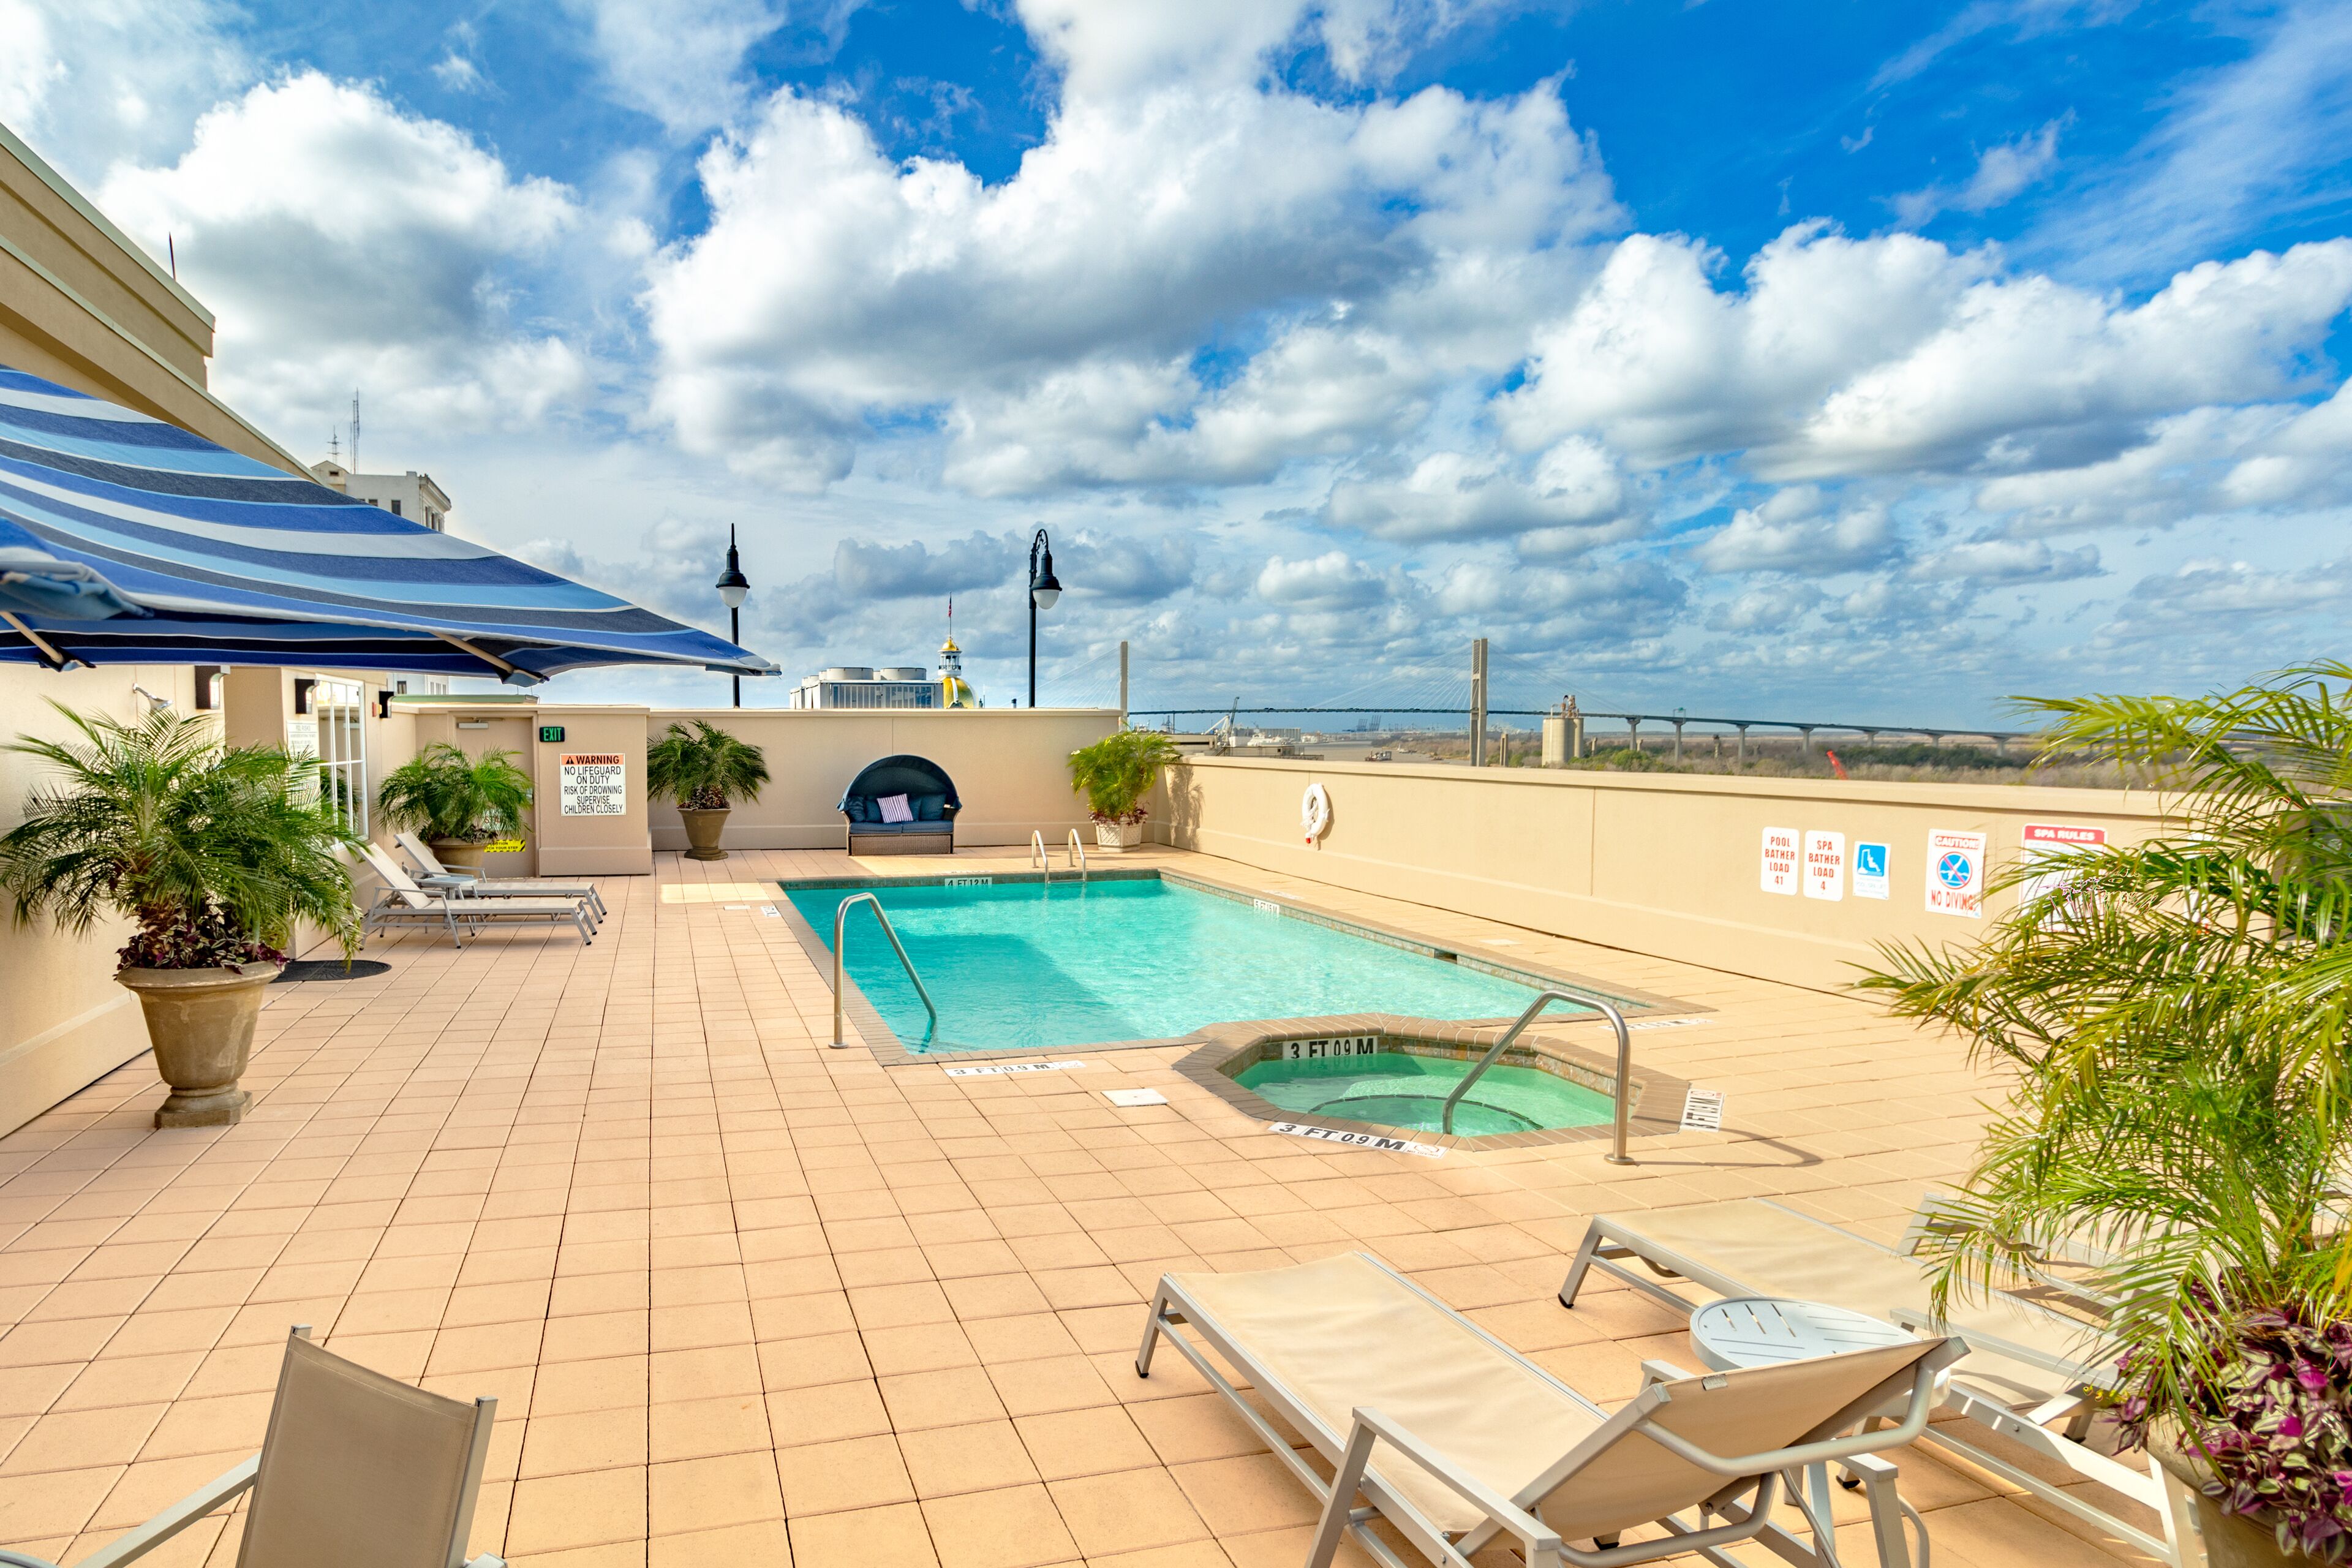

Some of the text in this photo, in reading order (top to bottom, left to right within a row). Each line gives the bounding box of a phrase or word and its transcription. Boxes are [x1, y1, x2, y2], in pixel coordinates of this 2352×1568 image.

[543, 728, 562, 741] EXIT
[576, 756, 619, 764] WARNING
[564, 766, 621, 775] NO LIFEGUARD
[576, 775, 610, 785] ON DUTY
[564, 785, 622, 795] RISK OF DROWNING
[577, 796, 610, 805] SUPERVISE
[564, 804, 623, 814] CHILDREN CLOSELY
[2034, 829, 2095, 841] SPA RULES
[1770, 836, 1790, 847] POOL
[1817, 840, 1833, 851] SPA
[1765, 848, 1795, 861] BATHER
[1809, 853, 1840, 865] BATHER
[1770, 862, 1790, 873] LOAD
[1813, 867, 1834, 878] LOAD
[1774, 876, 1783, 885] 41
[1820, 881, 1826, 891] 4
[1931, 889, 1942, 906] NO
[1291, 1042, 1300, 1058] 3
[1309, 1040, 1329, 1058] FT
[1357, 1038, 1374, 1055] M
[1303, 1128, 1338, 1139] FT
[1341, 1133, 1370, 1144] 0.9
[1374, 1139, 1406, 1150] M
